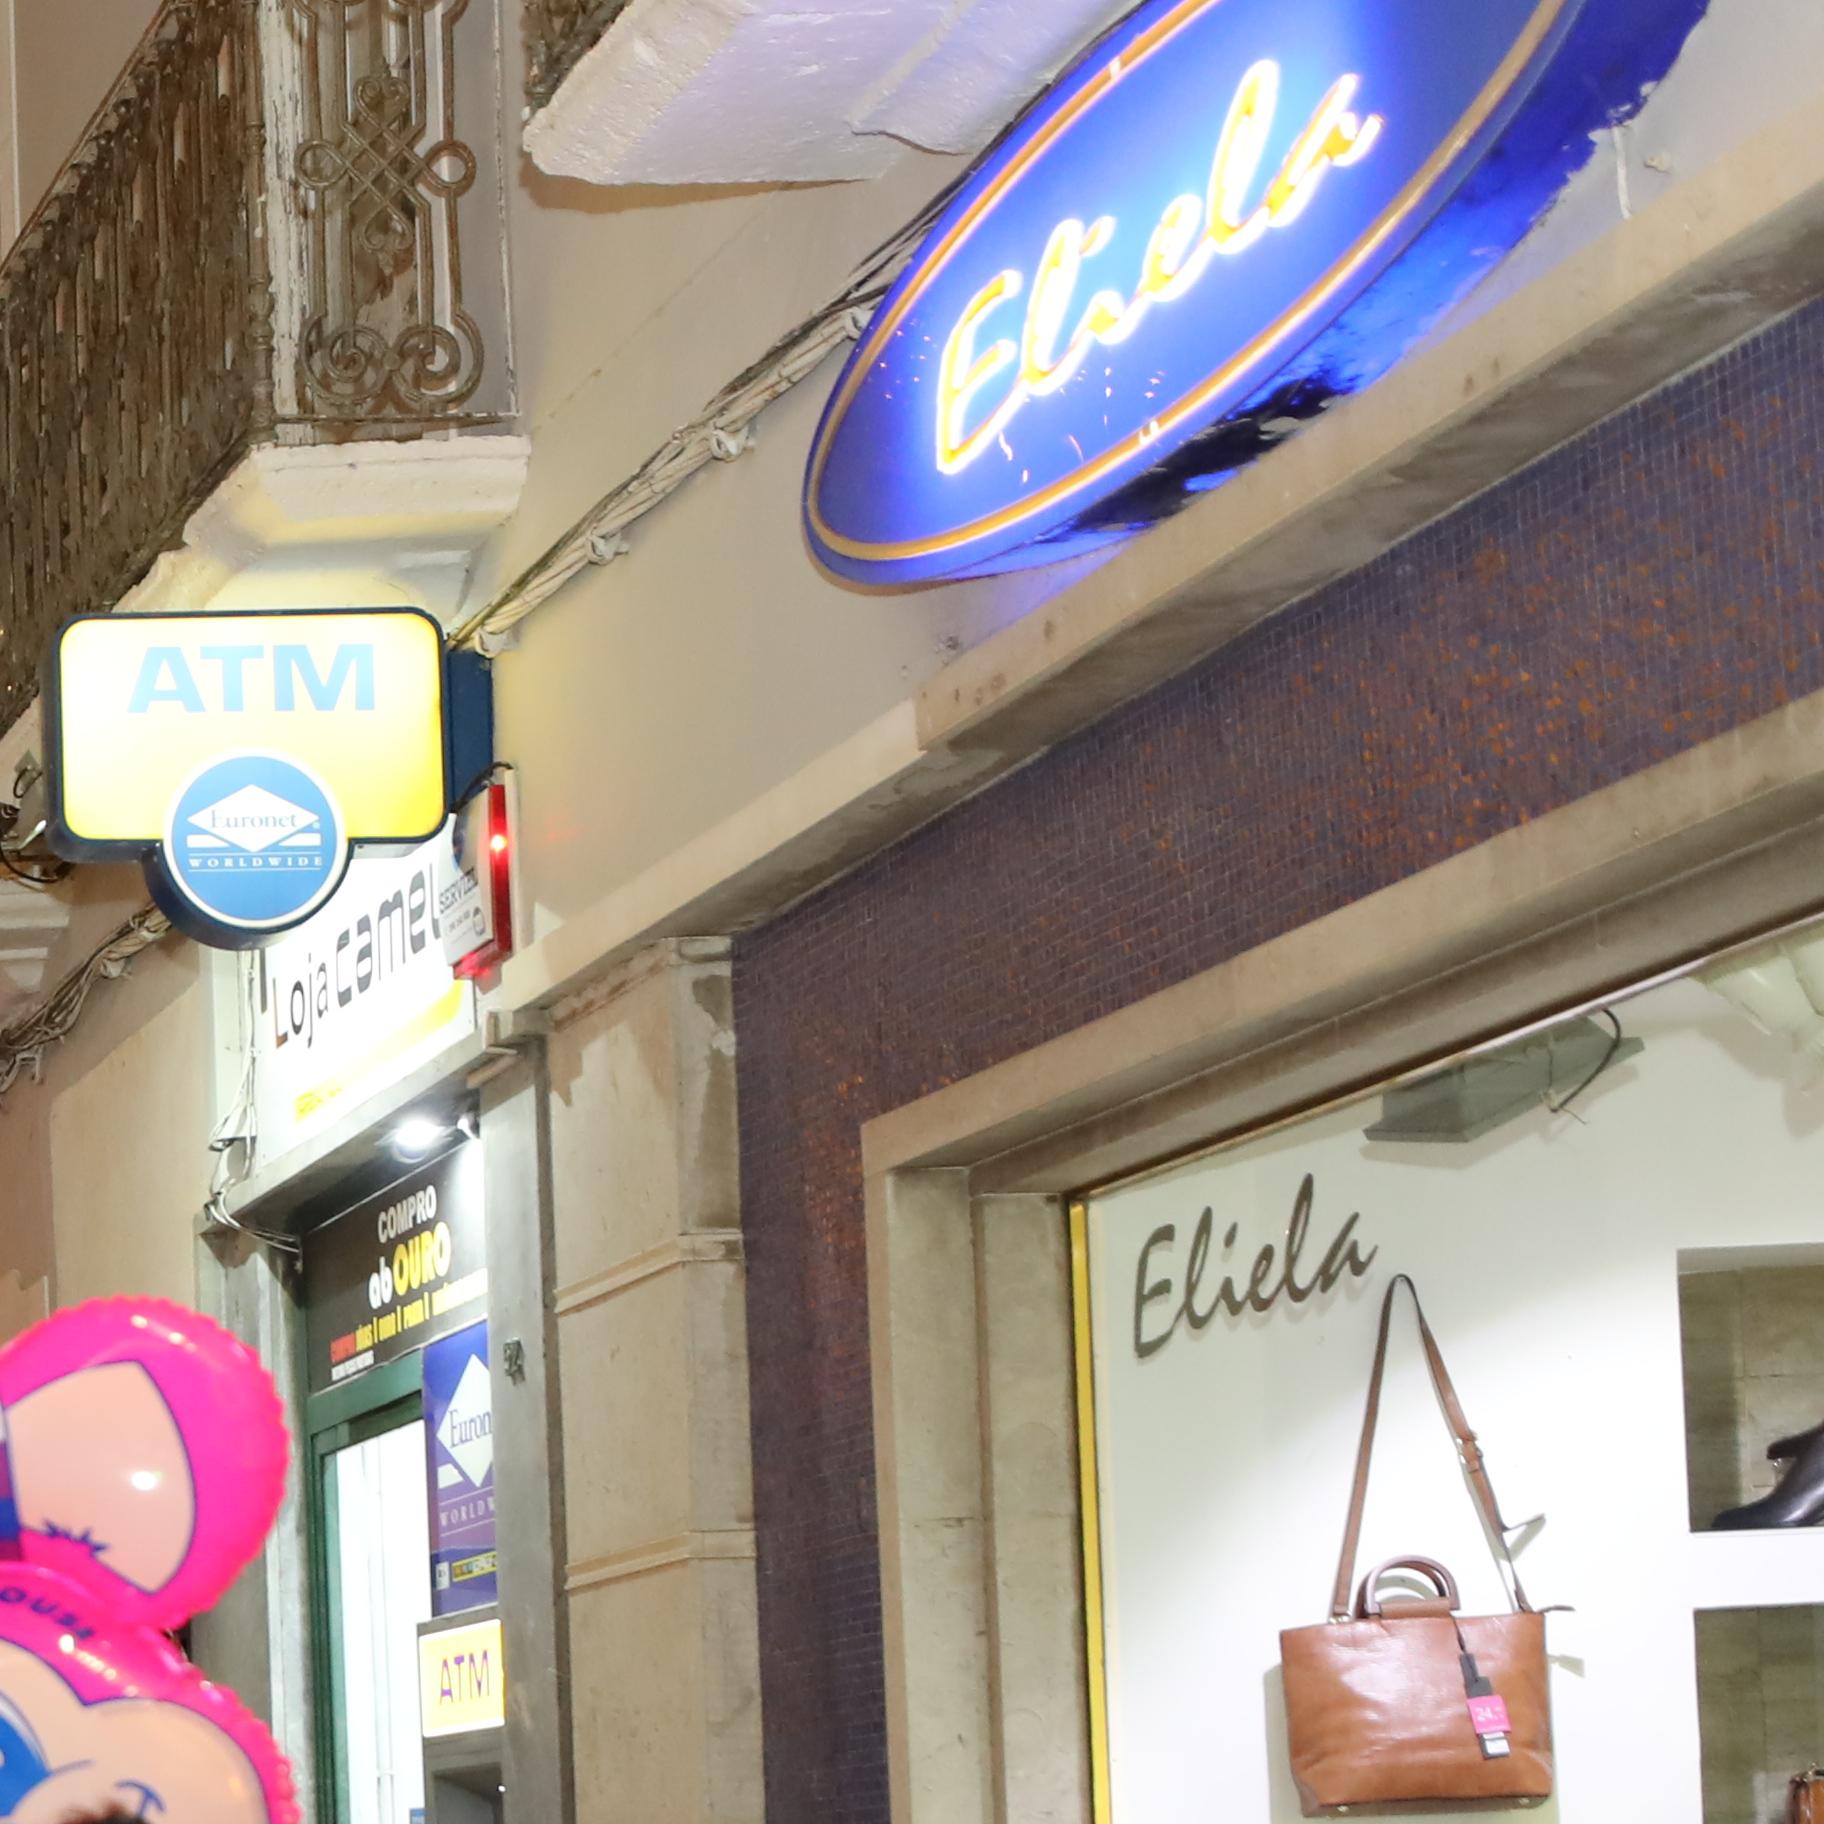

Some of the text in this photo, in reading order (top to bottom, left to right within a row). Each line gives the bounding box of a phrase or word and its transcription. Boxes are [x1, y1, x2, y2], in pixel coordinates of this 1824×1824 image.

[934, 58, 1385, 477] Eliela
[128, 643, 376, 714] ATM
[210, 808, 299, 830] Euronet
[187, 855, 324, 868] WORLDWIDE
[272, 952, 329, 1049] Loja
[377, 1184, 437, 1244] COMPRO
[1134, 1172, 1379, 1359] Eliela
[439, 1649, 491, 1705] ATM
